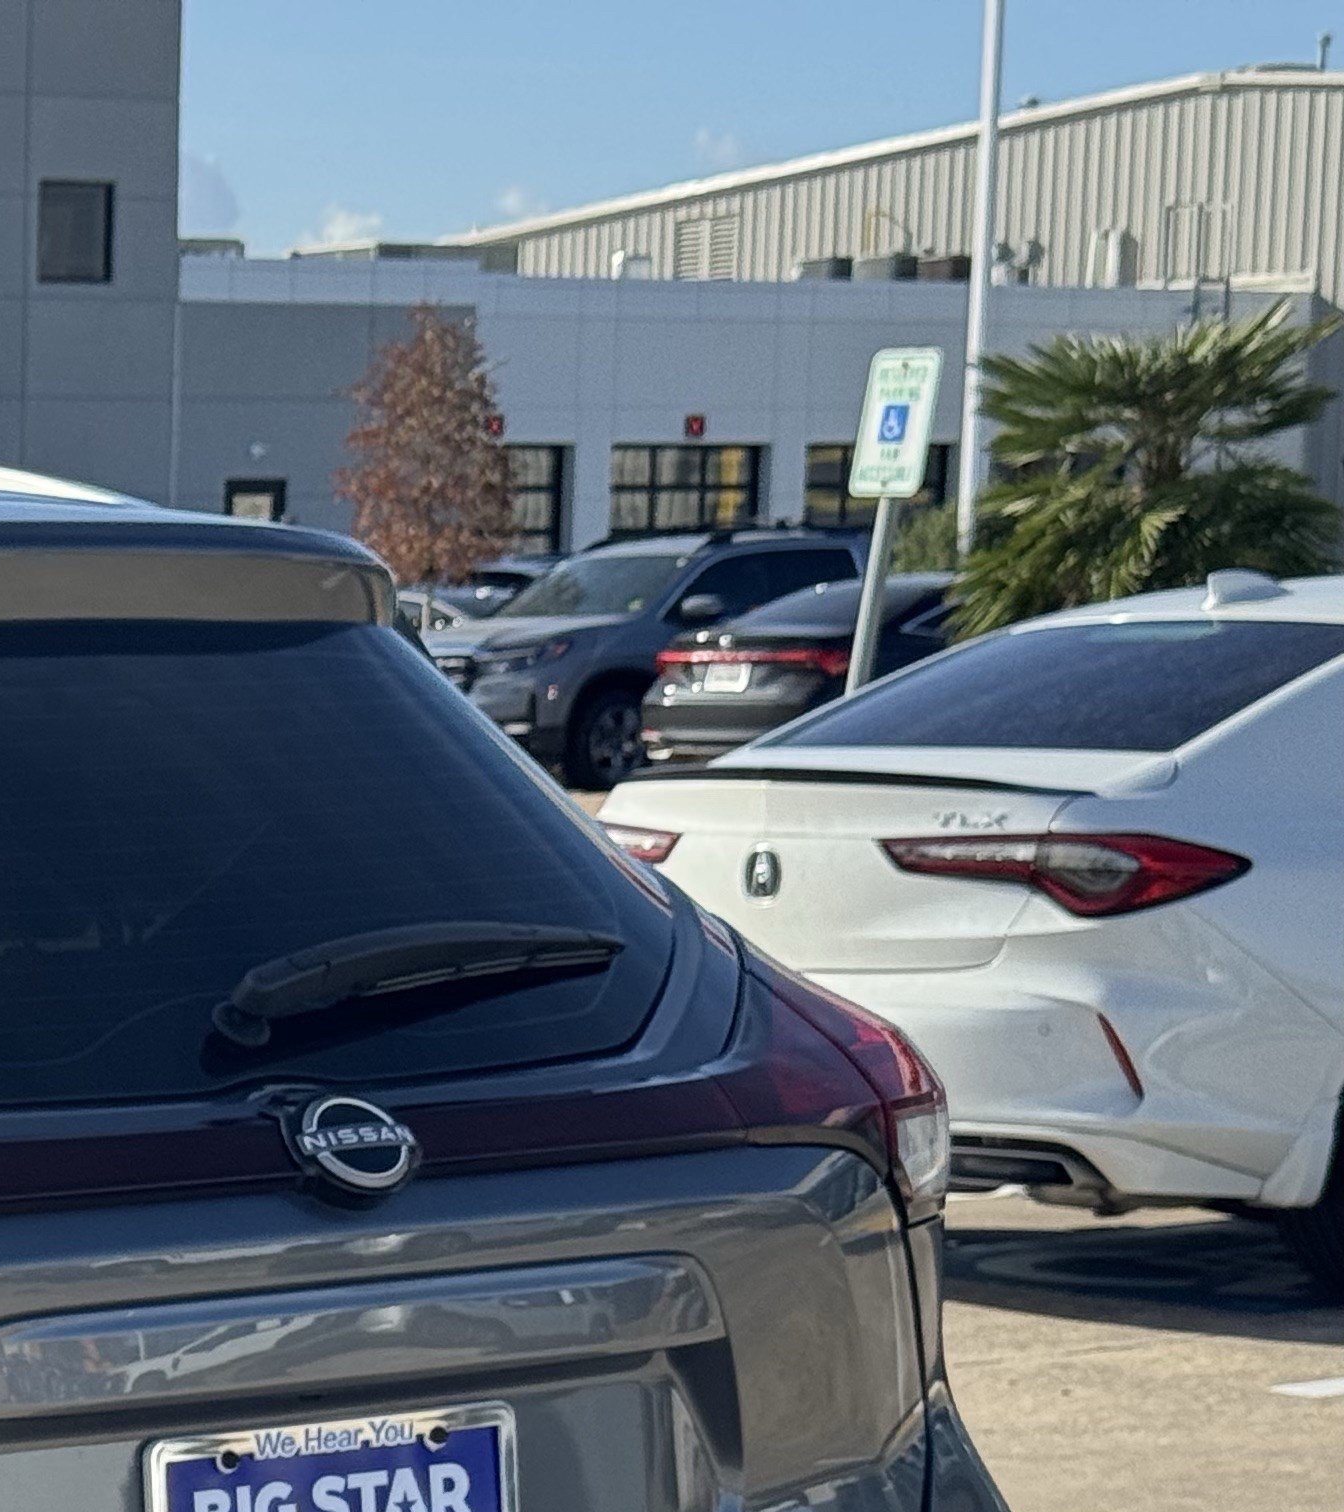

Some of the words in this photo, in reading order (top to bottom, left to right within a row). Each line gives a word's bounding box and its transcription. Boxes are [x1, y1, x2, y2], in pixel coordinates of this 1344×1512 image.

[302, 1125, 416, 1151] NISSAN
[253, 1431, 297, 1454] We
[303, 1426, 363, 1451] Hear
[368, 1419, 414, 1444] You
